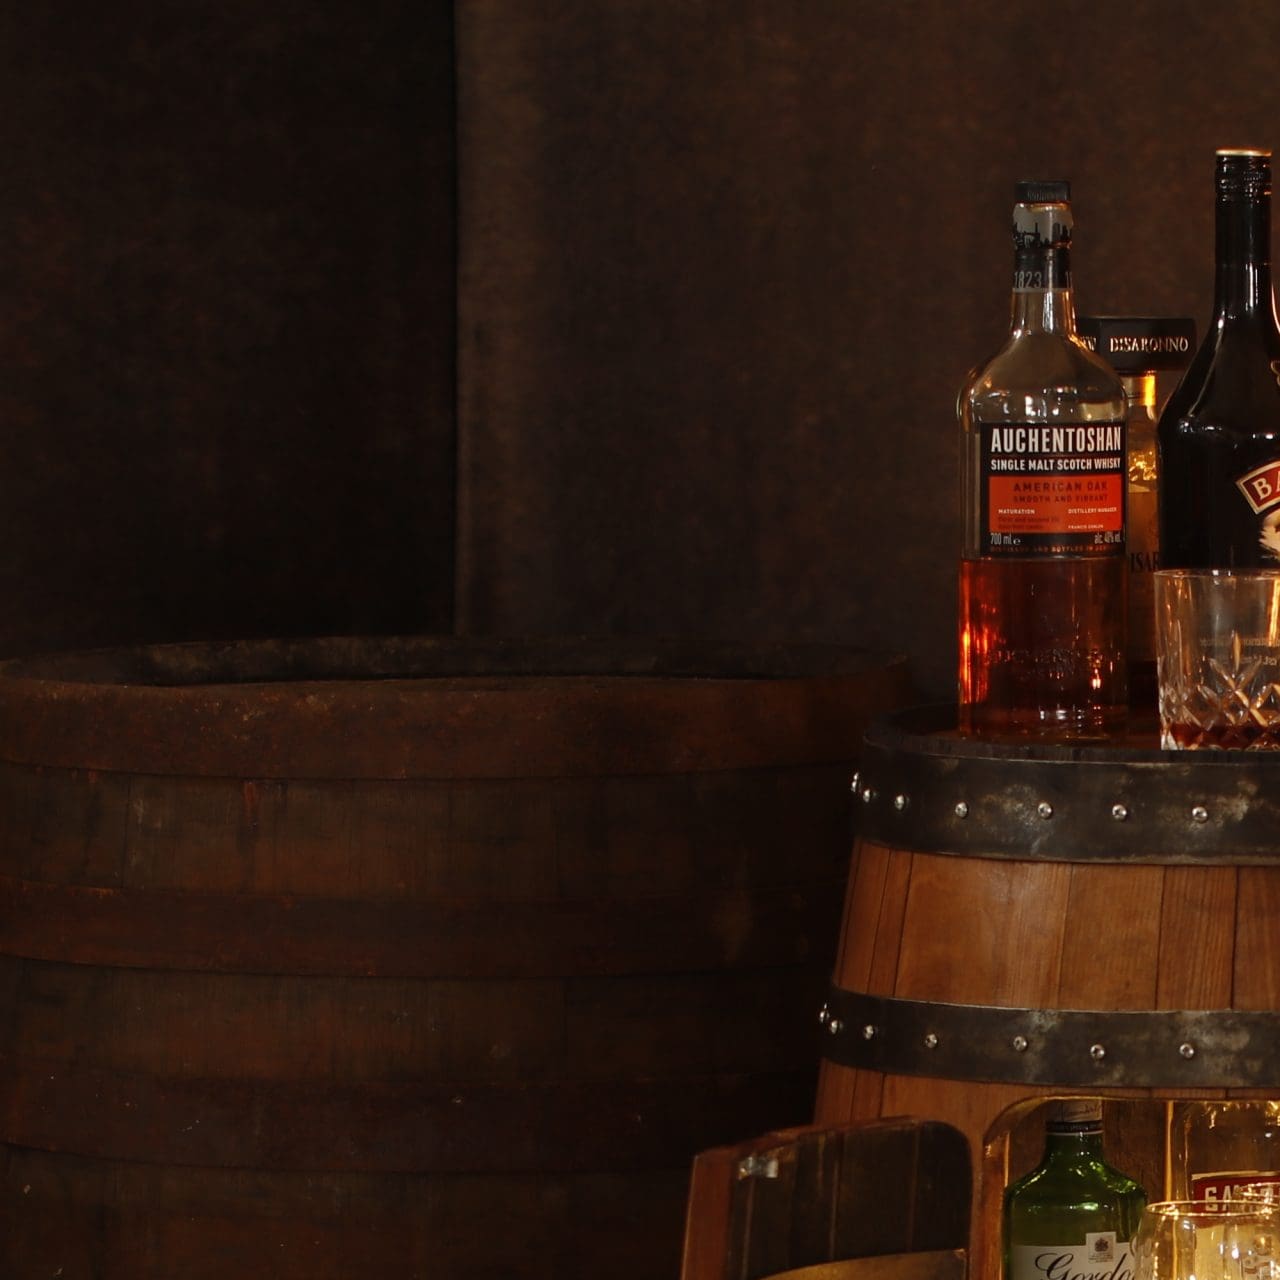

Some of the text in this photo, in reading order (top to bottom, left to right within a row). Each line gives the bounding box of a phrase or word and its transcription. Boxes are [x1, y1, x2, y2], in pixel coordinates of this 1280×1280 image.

[1014, 271, 1042, 289] 1823
[1109, 336, 1189, 352] DISARONNO
[991, 427, 1121, 453] AUCHENTOSHAN
[991, 457, 1121, 471] SINGLE MALT SCOTCH WHISKY
[1013, 481, 1107, 492] AMERICAN OAK
